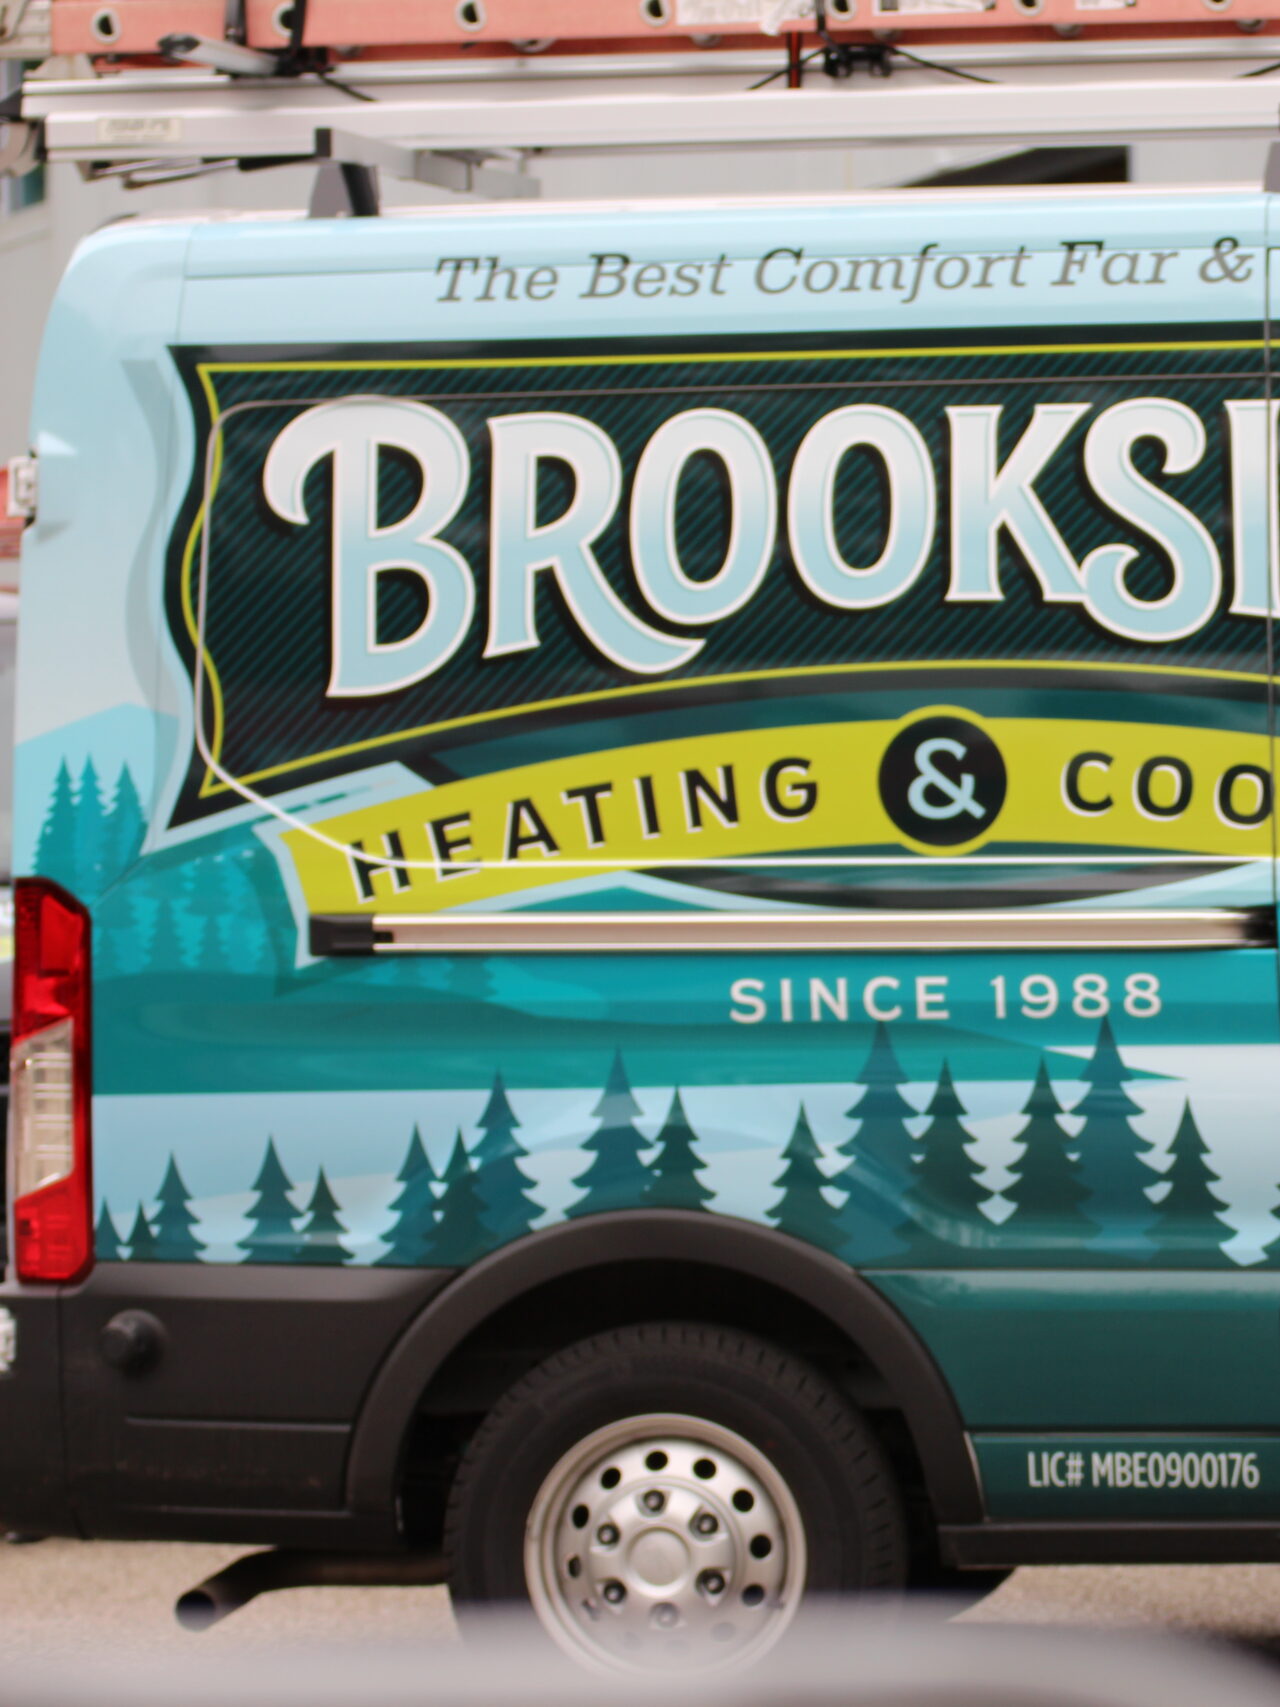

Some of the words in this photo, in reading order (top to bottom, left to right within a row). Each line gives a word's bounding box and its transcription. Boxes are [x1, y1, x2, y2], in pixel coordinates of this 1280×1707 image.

[436, 256, 558, 302] The
[579, 252, 733, 299] Best
[754, 243, 1032, 304] Comfort
[1050, 239, 1179, 287] Far
[1197, 236, 1254, 284] &
[346, 757, 819, 903] HEATING
[907, 737, 987, 820] &
[729, 975, 950, 1023] SINCE
[990, 972, 1162, 1019] 1988
[1028, 1451, 1084, 1487] LIC#
[1091, 1451, 1260, 1488] MBE0900176
